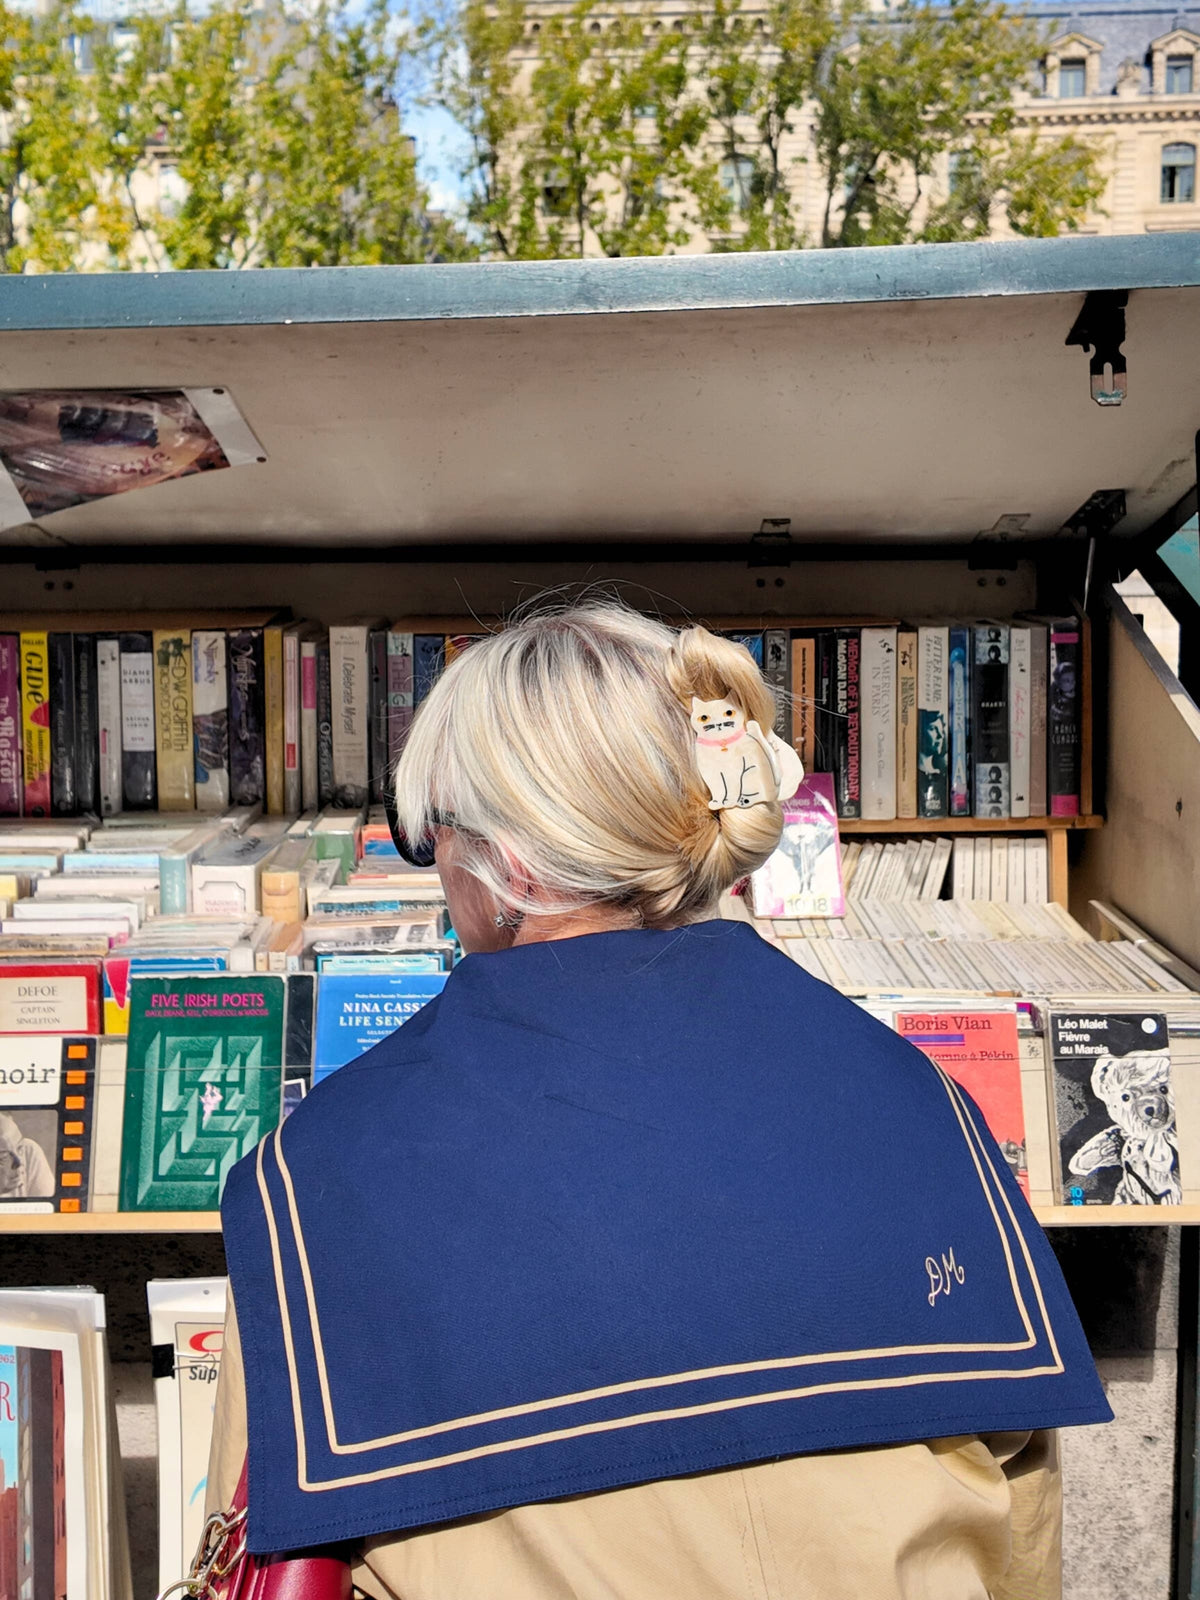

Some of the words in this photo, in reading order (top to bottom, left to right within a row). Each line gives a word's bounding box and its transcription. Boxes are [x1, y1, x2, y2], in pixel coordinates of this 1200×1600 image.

[932, 635, 942, 673] BITTER
[393, 659, 406, 690] THE
[872, 666, 881, 679] IN
[342, 662, 356, 705] Celebrate
[932, 676, 942, 704] FAME
[881, 656, 892, 725] AMERICANS
[872, 684, 881, 716] PARIS
[172, 695, 188, 752] GRIFFITH
[341, 705, 357, 737] Myself
[813, 898, 828, 912] 18
[17, 985, 58, 997] DEFOE
[151, 993, 180, 1008] FIVE
[183, 993, 218, 1008] IRISH
[222, 992, 265, 1008] POETS
[20, 1006, 56, 1014] CAPTAIN
[343, 1002, 380, 1013] NINA
[16, 1016, 61, 1025] SINGLETON
[339, 1016, 372, 1027] LIFE
[902, 1016, 951, 1031] Boris
[954, 1016, 993, 1030] Vian
[1058, 1018, 1077, 1029] Léo
[1079, 1018, 1108, 1029] Malet
[1058, 1031, 1091, 1043] Fièvre
[979, 1051, 1014, 1061] Pékin
[1060, 1046, 1072, 1055] au
[1074, 1044, 1109, 1055] Marais
[1069, 1186, 1083, 1198] 10
